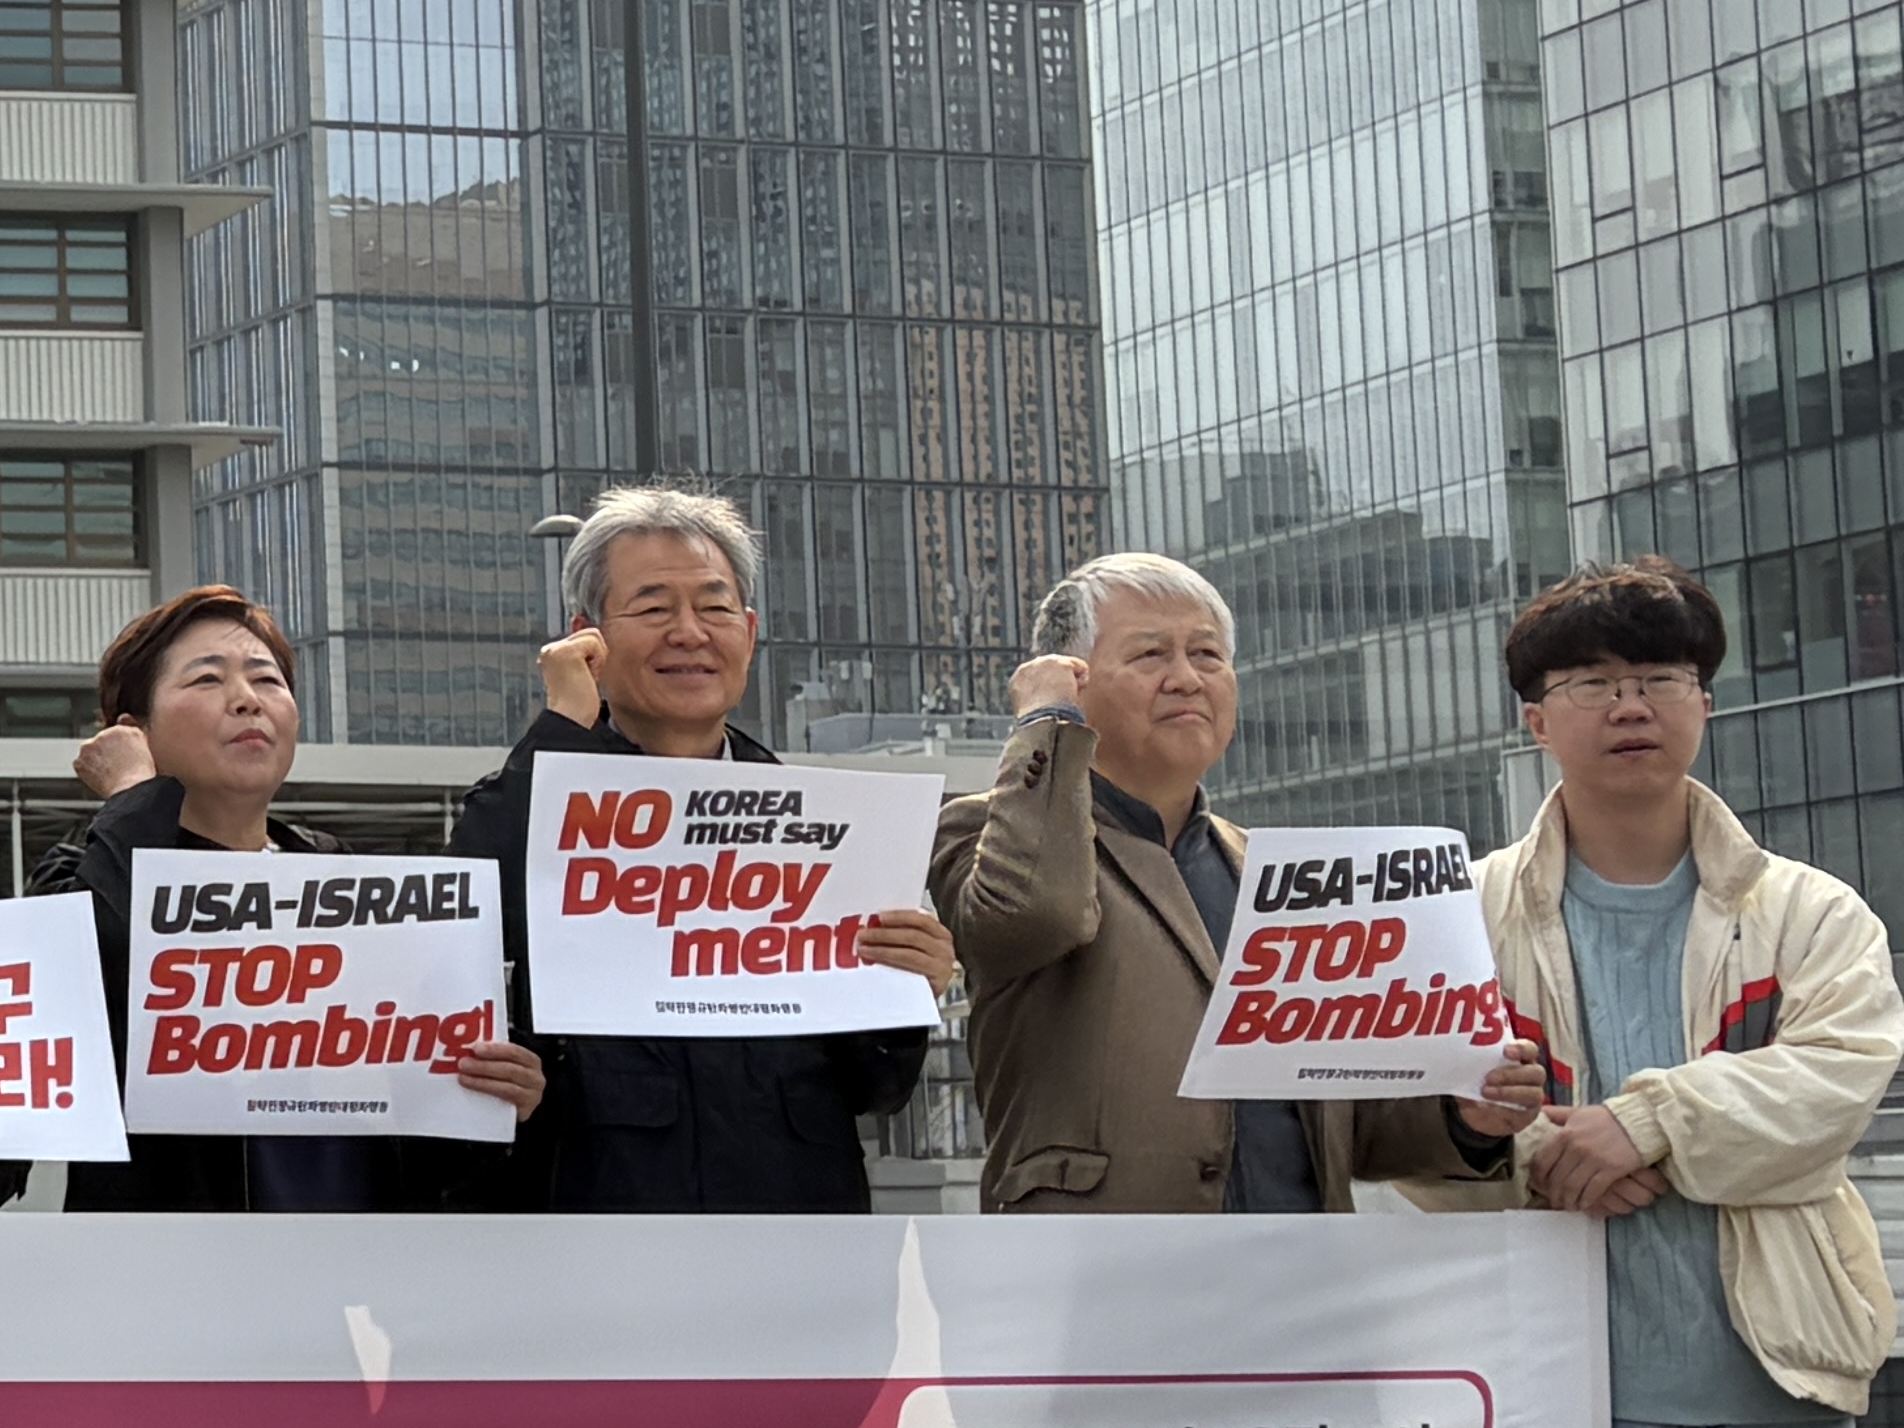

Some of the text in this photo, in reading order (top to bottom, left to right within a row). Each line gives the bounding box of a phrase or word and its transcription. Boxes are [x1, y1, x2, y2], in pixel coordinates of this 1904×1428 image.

[558, 788, 673, 851] NO
[684, 818, 849, 851] must say
[685, 789, 803, 817] KOREA
[151, 872, 479, 934] USA-ISRAEL
[562, 849, 832, 928] Deploy
[1253, 843, 1473, 913] USA-ISRAEL
[143, 943, 342, 1011] STOP
[1229, 917, 1406, 986] STOP
[1215, 973, 1508, 1046] Bombing
